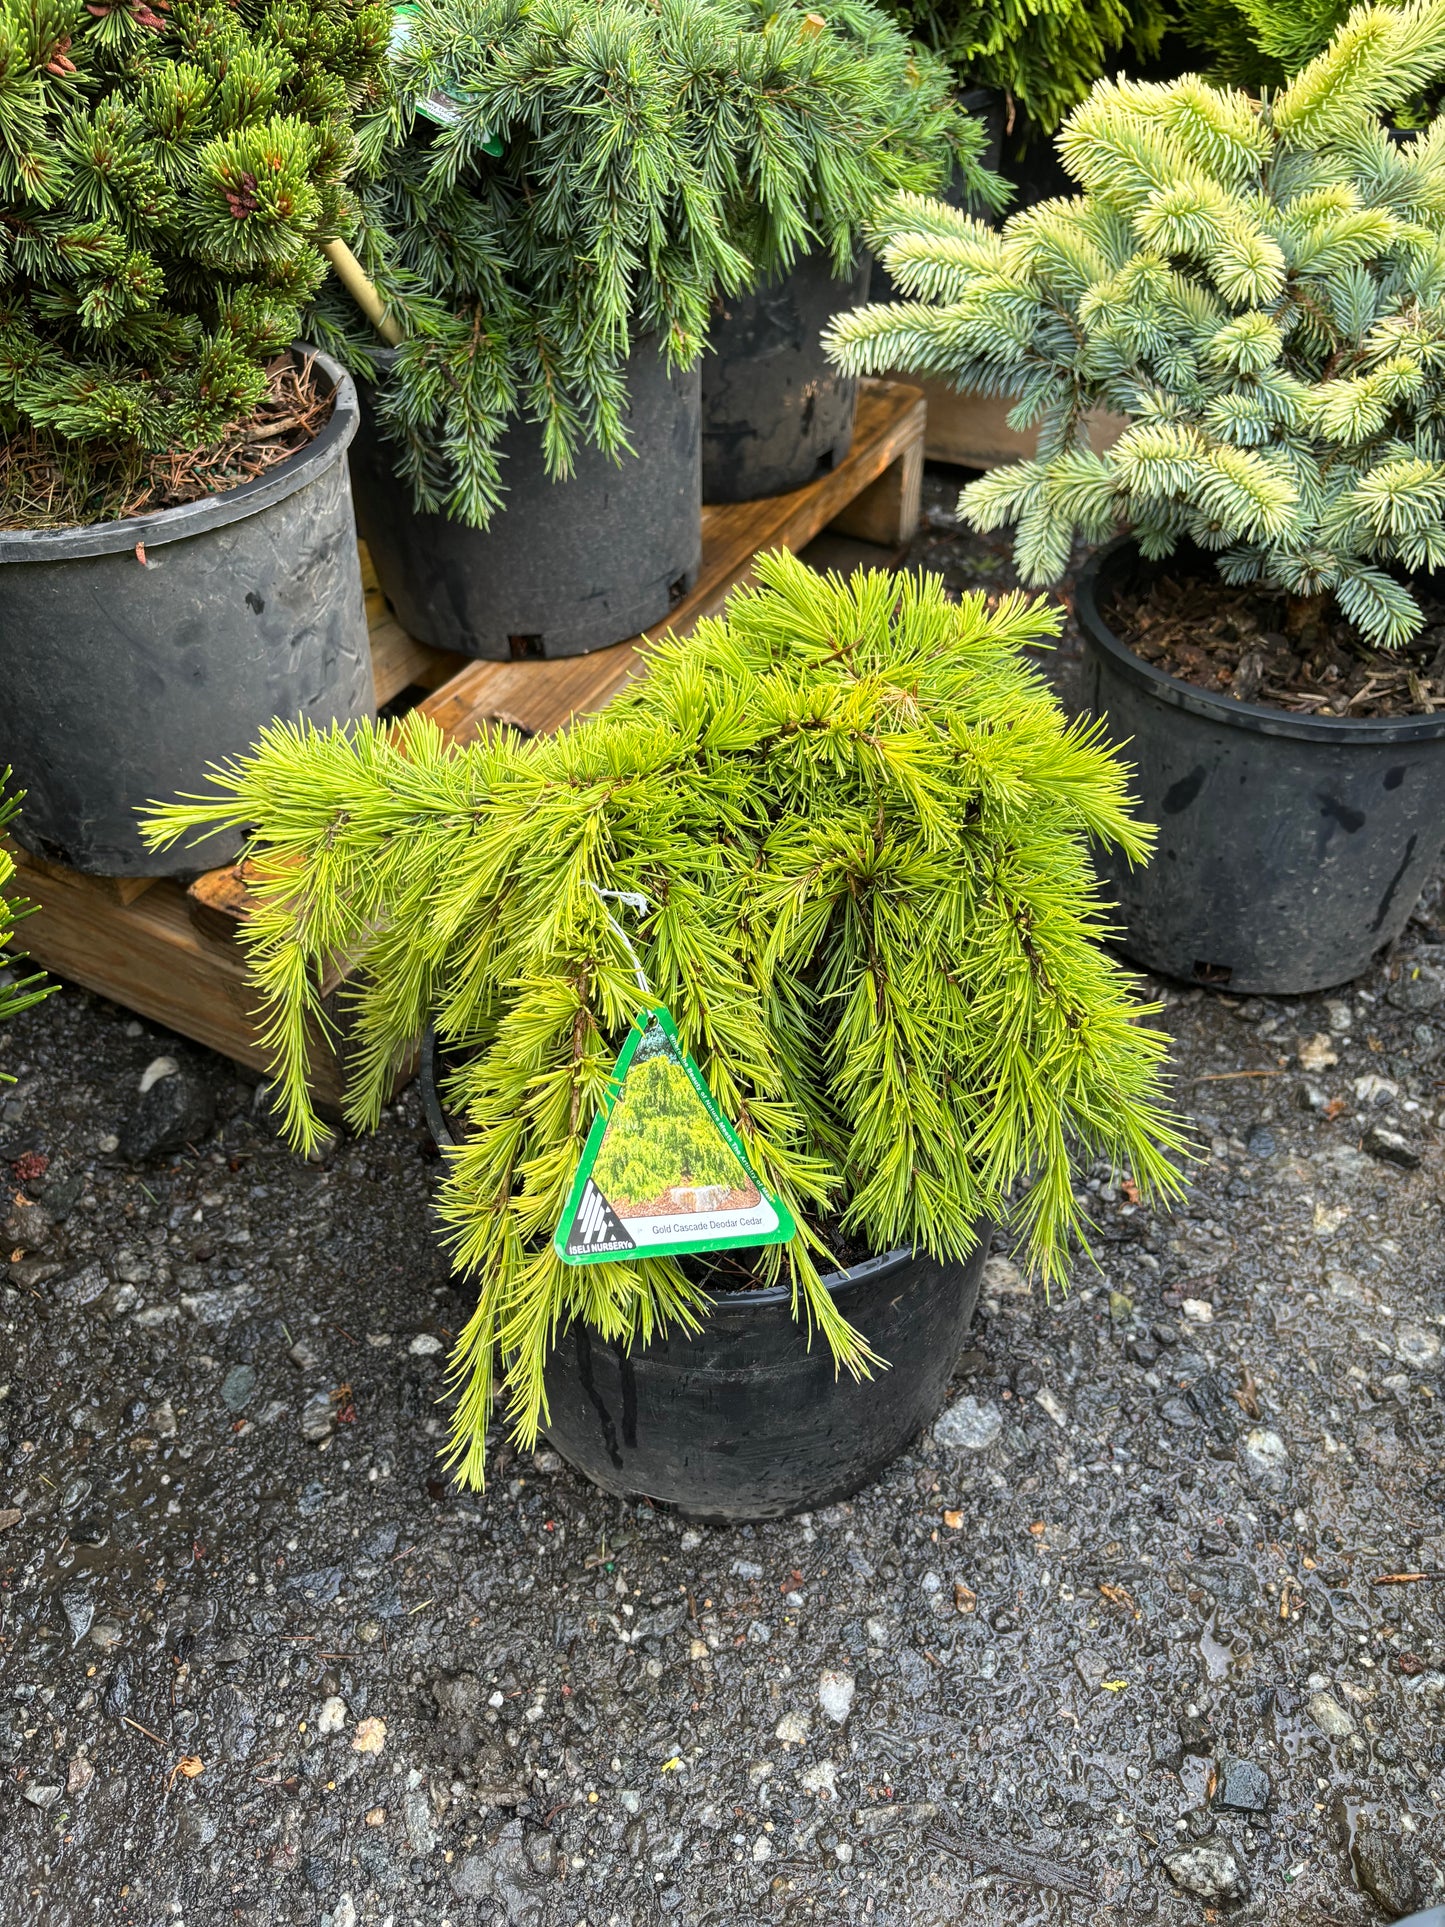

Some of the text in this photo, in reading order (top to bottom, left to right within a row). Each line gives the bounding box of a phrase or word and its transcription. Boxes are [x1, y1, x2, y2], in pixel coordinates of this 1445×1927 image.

[670, 1033, 682, 1055] Where
[687, 1068, 702, 1090] Beauty
[700, 1091, 708, 1099] of
[705, 1099, 720, 1122] Nature
[718, 1122, 733, 1142] Meets
[731, 1142, 741, 1155] The
[740, 1156, 757, 1179] Artistry
[756, 1179, 763, 1187] of
[652, 1217, 763, 1234] Gold Cascade Deodar Cedar
[569, 1243, 590, 1255] ISELI
